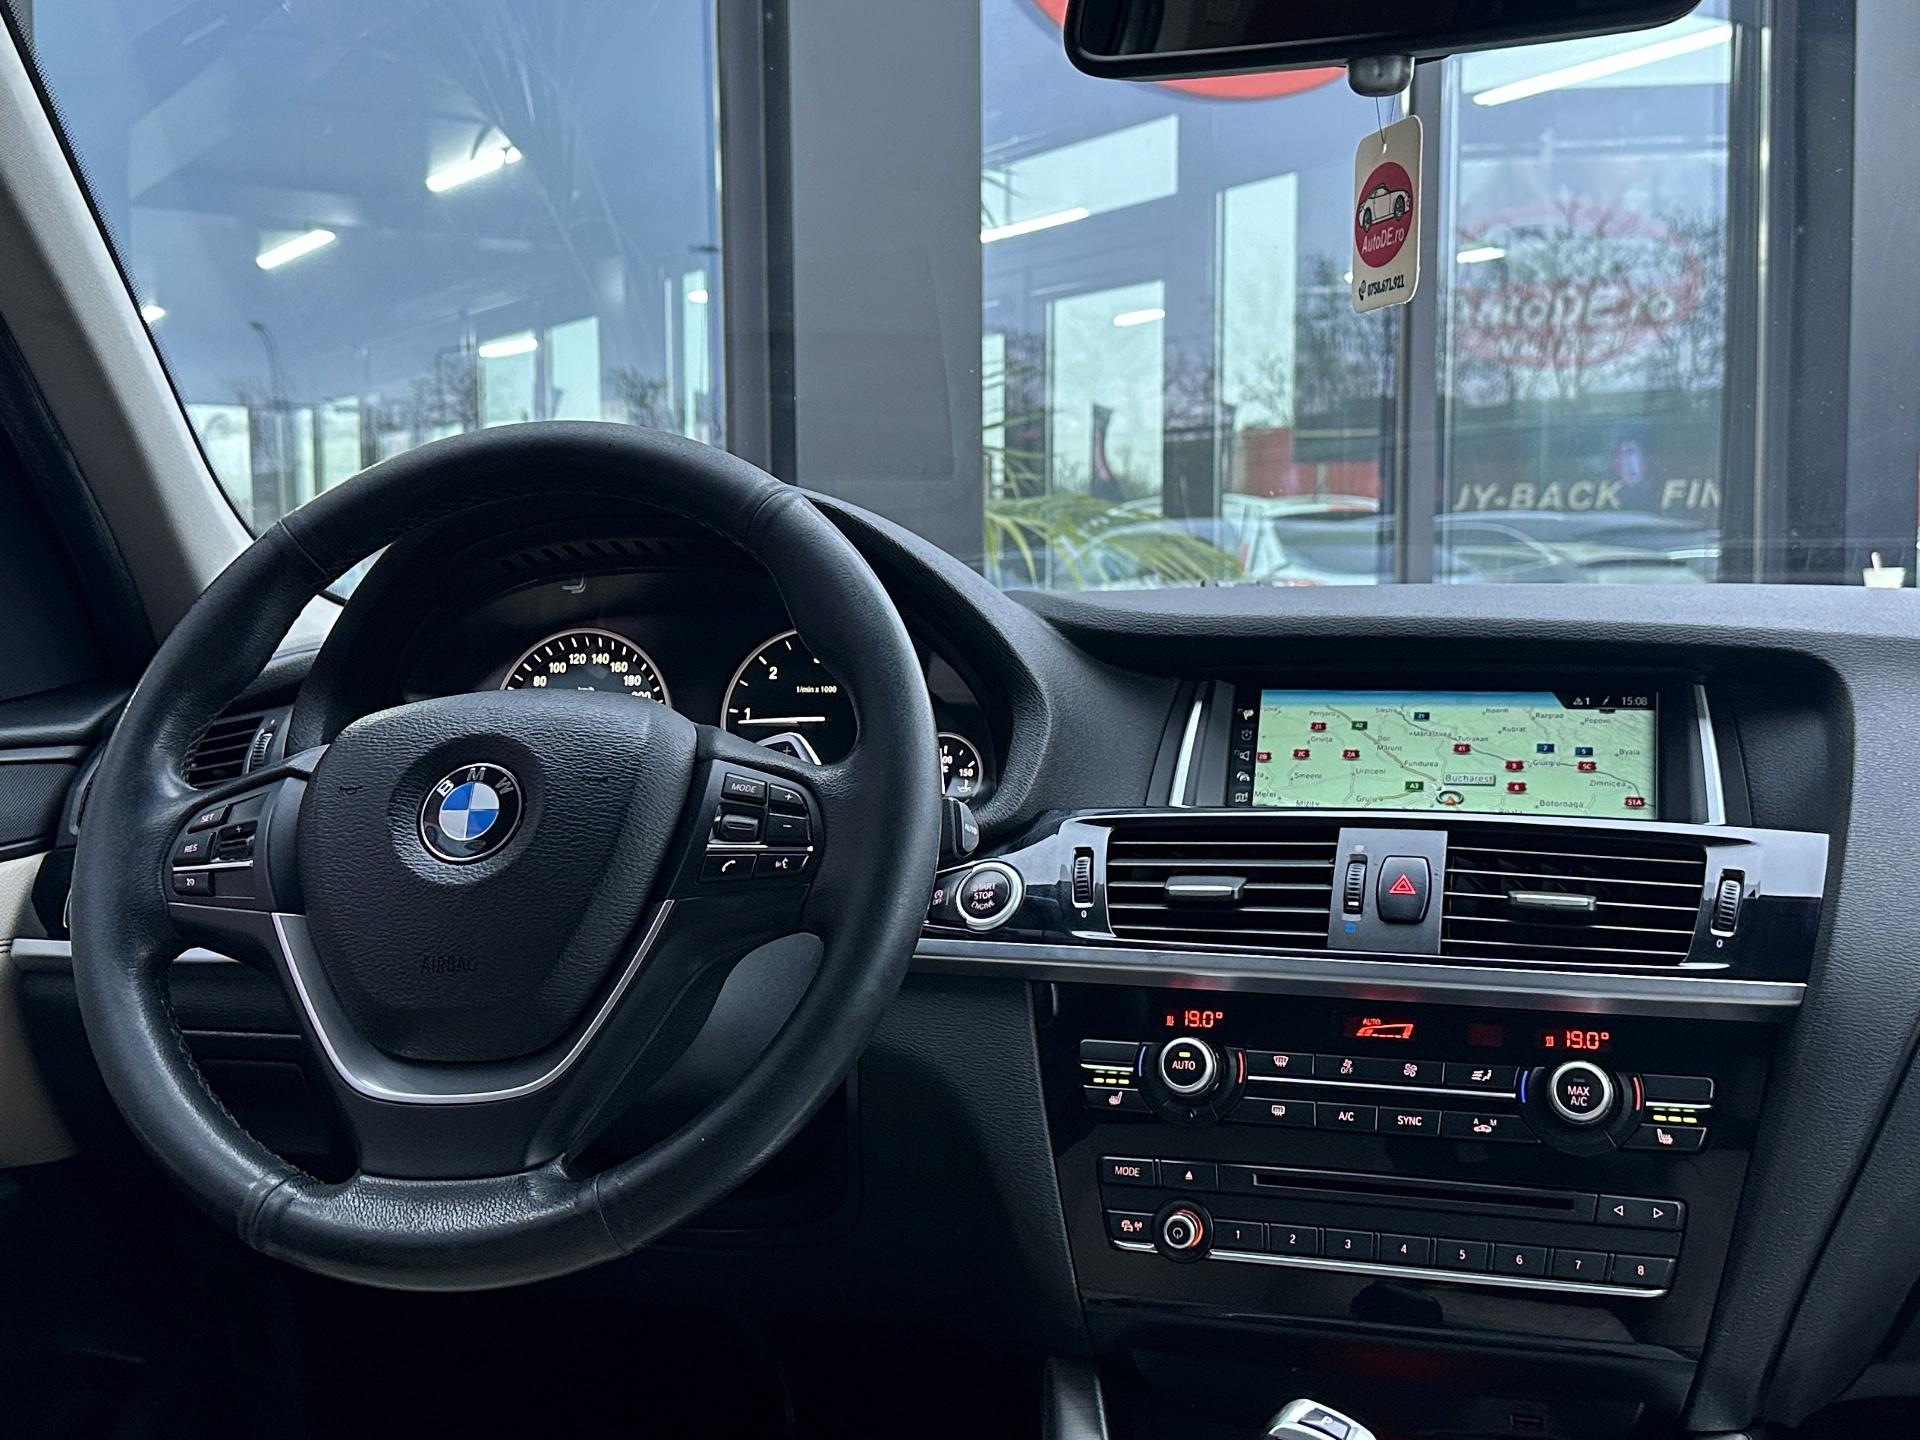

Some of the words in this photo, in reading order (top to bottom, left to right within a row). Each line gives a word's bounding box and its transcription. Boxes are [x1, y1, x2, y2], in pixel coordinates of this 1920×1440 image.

[1361, 226, 1405, 254] AutoDE.ro
[569, 653, 587, 665] 120
[592, 653, 610, 665] 140
[549, 662, 567, 674] 100
[610, 662, 628, 673] 160
[768, 666, 778, 680] 2
[533, 675, 547, 687] 80
[623, 675, 642, 687] 180
[1621, 696, 1648, 706] 15:08
[744, 707, 751, 720] 1
[942, 755, 953, 764] 00
[958, 768, 974, 777] 150
[436, 766, 515, 798] BMW
[1445, 774, 1493, 784] Bucharest
[1589, 780, 1627, 789] Zimnicea
[731, 782, 757, 793] MODE
[200, 813, 216, 823] SET
[184, 844, 199, 853] RES
[971, 882, 997, 893] START
[973, 891, 995, 901] STOP
[970, 900, 996, 911] ENGINE
[1362, 1018, 1382, 1026] AUTO
[1171, 1060, 1197, 1071] AUTO
[1340, 1067, 1354, 1075] OFF
[1567, 1085, 1591, 1097] MAX
[1570, 1096, 1589, 1107] A/C
[1338, 1111, 1355, 1122] A/C
[1397, 1115, 1423, 1127] SYNC
[1114, 1166, 1141, 1178] MODE
[1235, 1230, 1241, 1240] 1
[1289, 1234, 1296, 1244] 2
[1344, 1239, 1352, 1249] 3
[1400, 1244, 1408, 1254] 4
[1458, 1249, 1466, 1260] 5
[1515, 1255, 1524, 1265] 6
[1574, 1260, 1582, 1270] 7
[1636, 1265, 1645, 1276] 8
[1321, 1416, 1333, 1427] P
